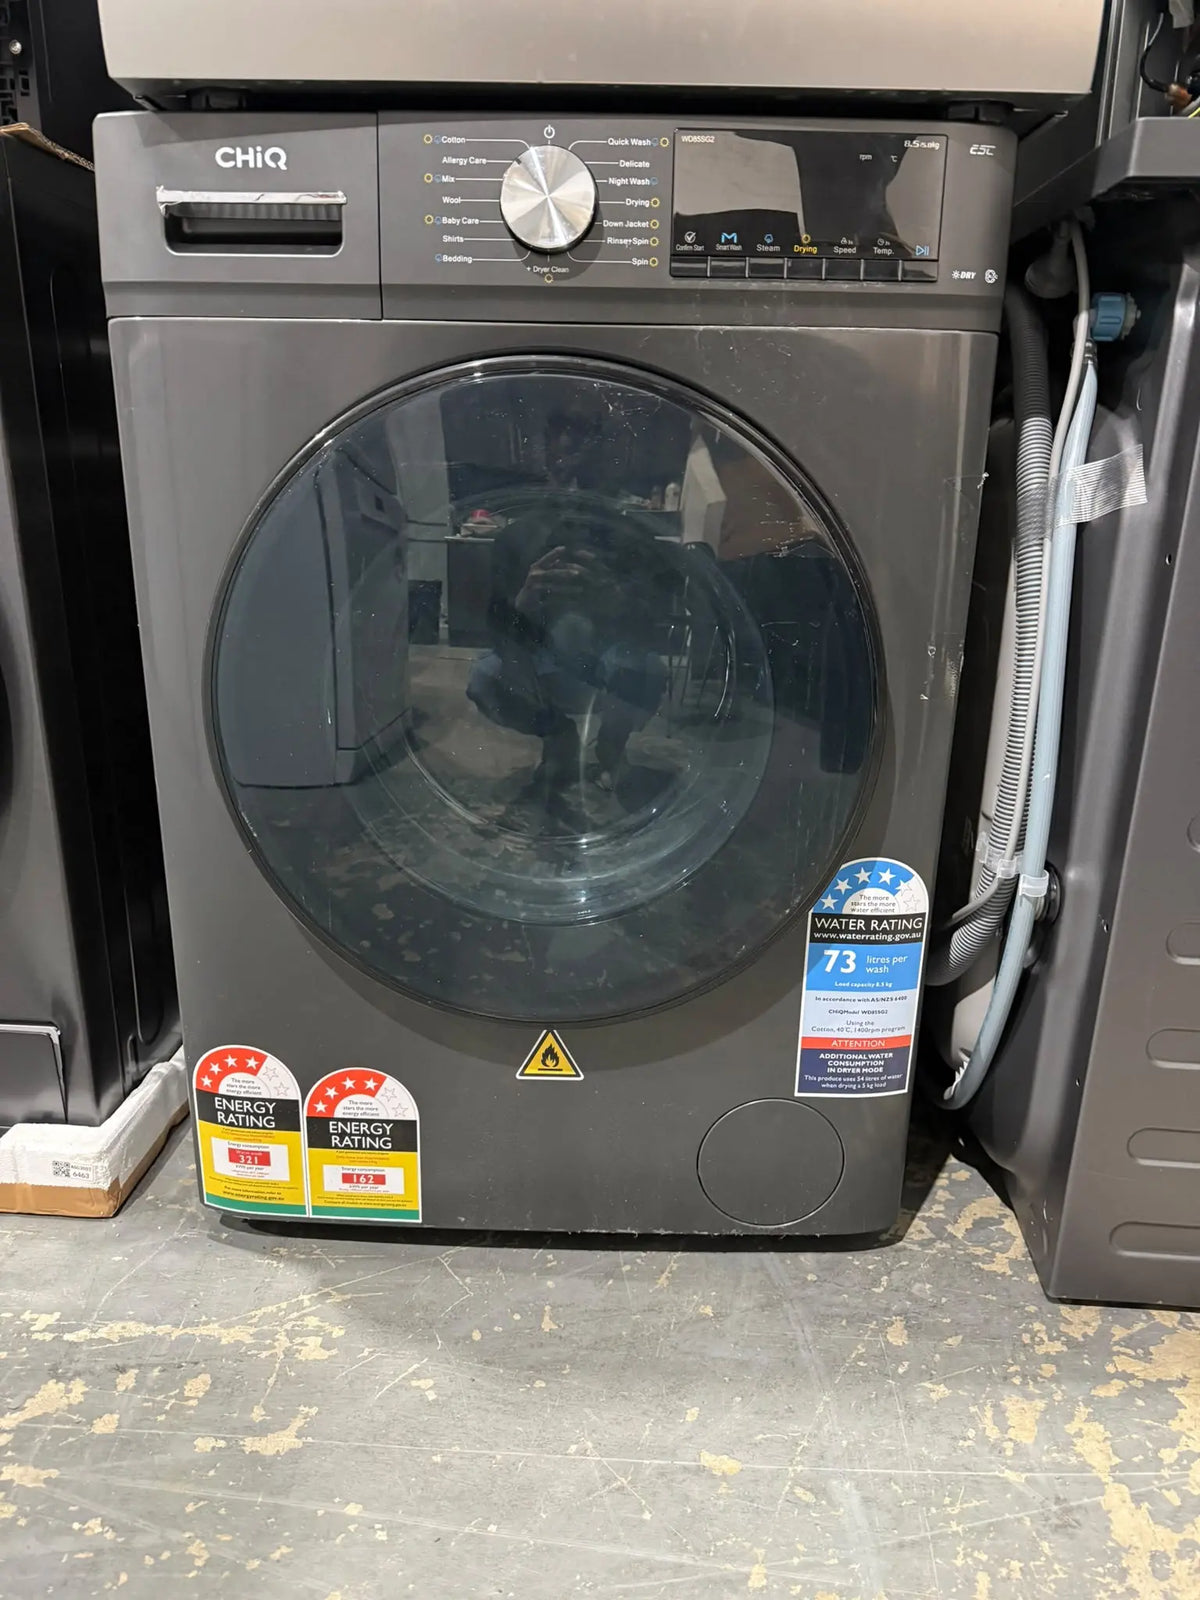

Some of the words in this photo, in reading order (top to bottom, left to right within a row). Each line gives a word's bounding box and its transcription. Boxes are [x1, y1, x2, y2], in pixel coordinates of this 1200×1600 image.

[442, 136, 466, 144] Cotton
[608, 138, 629, 146] Quick
[630, 138, 650, 146] Wash
[442, 157, 468, 166] Allergy
[468, 157, 487, 165] Care
[619, 160, 650, 168] Delicate
[442, 175, 456, 183] Mix
[608, 178, 629, 186] Night
[630, 178, 650, 186] Wash
[442, 196, 461, 204] Wool
[626, 198, 650, 208] Drying
[442, 217, 461, 226] Baby
[462, 217, 480, 225] Care
[603, 220, 624, 228] Down
[624, 220, 650, 228] Jacket
[442, 235, 464, 243] Shirts
[694, 244, 704, 252] Start
[756, 244, 780, 252] Steam
[794, 245, 818, 254] Drying
[833, 246, 856, 255] Speed
[873, 246, 894, 256] Temp.
[442, 254, 472, 264] Bedding
[632, 258, 649, 267] Spin
[533, 266, 550, 274] Dryer
[960, 271, 976, 279] DRY
[815, 917, 866, 931] WATER
[870, 917, 923, 931] RATING
[814, 931, 921, 942] www.waterrating.gov.au
[823, 949, 857, 974] 73
[866, 955, 890, 964] litres
[892, 956, 908, 966] per
[866, 964, 889, 974] wash
[881, 1026, 906, 1034] program
[831, 1040, 886, 1048] ATTENTION
[868, 1052, 894, 1060] WATER
[838, 1082, 857, 1090] drying
[866, 1082, 874, 1090] kg
[214, 1096, 276, 1114] ENERGY
[217, 1111, 276, 1128] RATING
[329, 1121, 394, 1136] ENERGY
[331, 1135, 392, 1150] RATING
[239, 1155, 258, 1164] 321
[353, 1174, 374, 1184] 162
